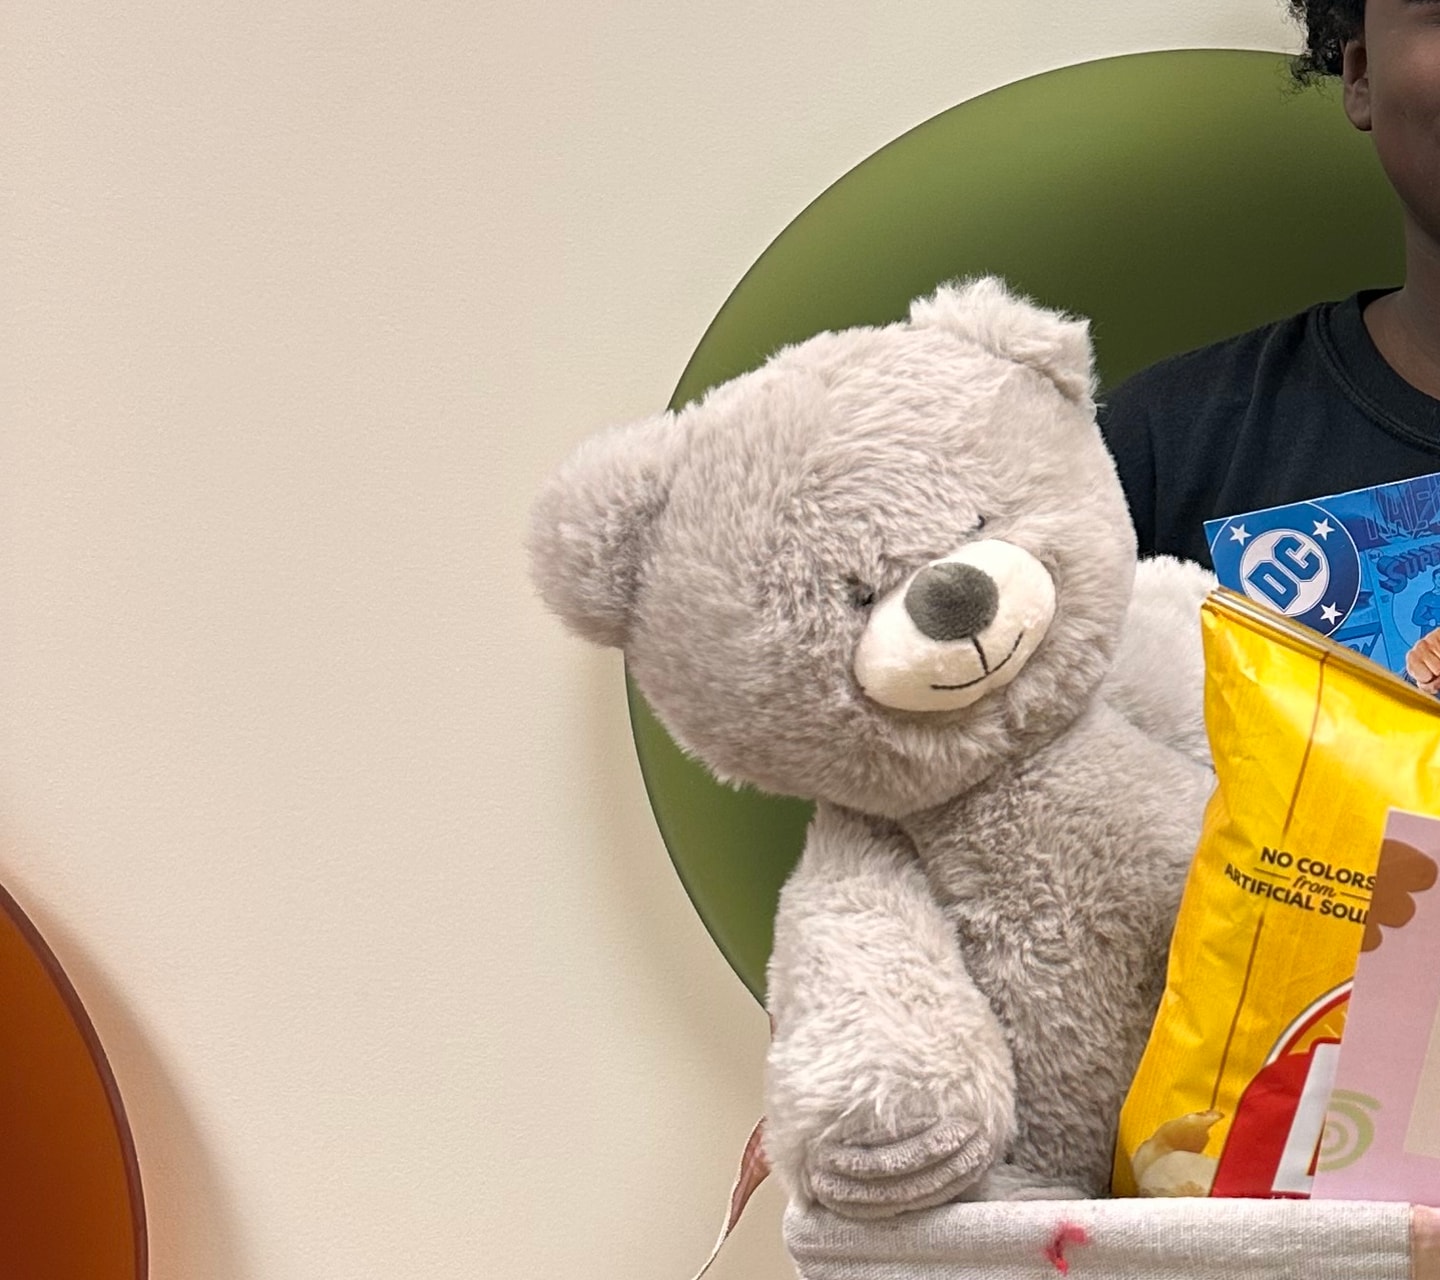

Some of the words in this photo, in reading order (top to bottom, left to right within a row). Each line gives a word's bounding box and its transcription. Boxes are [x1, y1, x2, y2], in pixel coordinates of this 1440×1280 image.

[1245, 534, 1323, 613] DC
[1224, 863, 1315, 911] ARTIFICIAL
[1260, 846, 1293, 868] NO
[1297, 857, 1376, 891] COLORS
[1292, 875, 1336, 898] from
